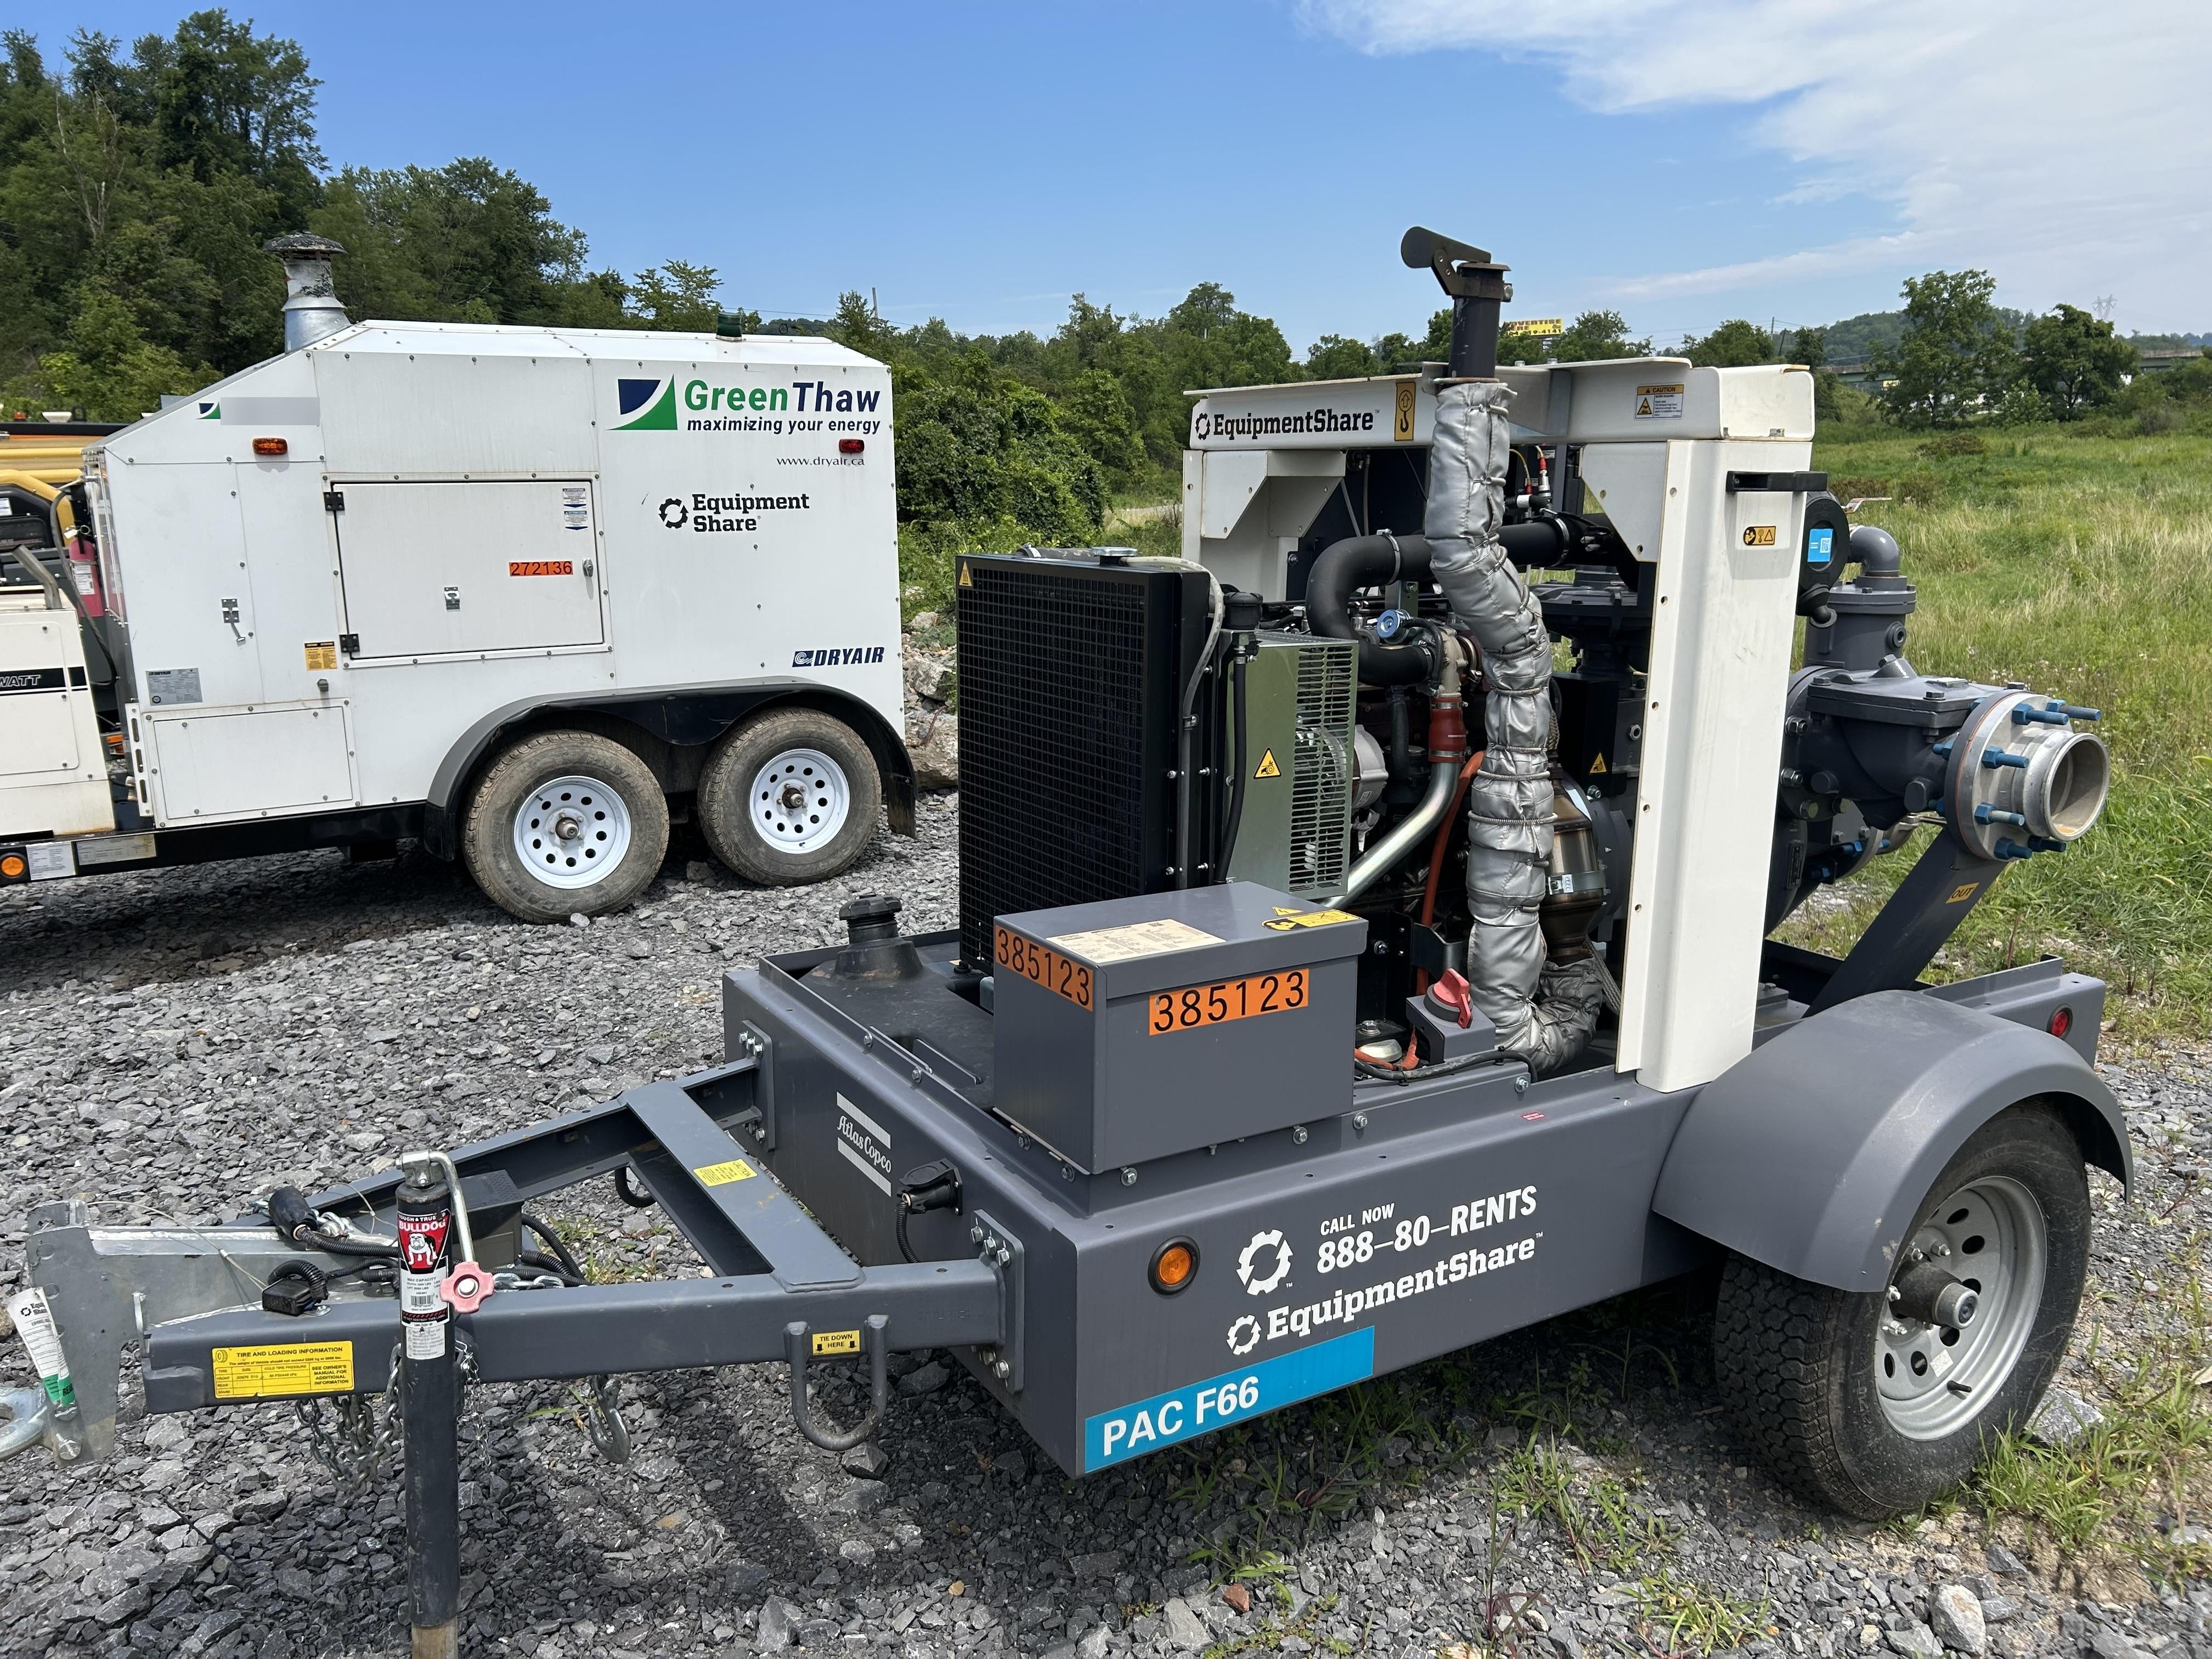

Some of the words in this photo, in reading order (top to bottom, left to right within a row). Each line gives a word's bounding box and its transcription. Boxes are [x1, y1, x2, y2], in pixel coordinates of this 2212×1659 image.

[687, 416, 782, 434] maximizing
[788, 419, 823, 435] your
[828, 419, 881, 435] energy
[1214, 409, 1373, 440] EquipmentShare
[776, 456, 865, 466] www.dryair.ca
[692, 493, 810, 514] Equipment
[693, 515, 757, 532] Share
[511, 561, 572, 576] 272136
[814, 647, 885, 666] DRYAIR
[1951, 887, 1974, 898] OUT
[997, 928, 1091, 1007] 385123
[1154, 971, 1304, 1031] 385123
[733, 1162, 751, 1177] CAUTION
[399, 1219, 446, 1232] BULLDOG
[1320, 1211, 1355, 1235] CALL
[1362, 1203, 1395, 1225] NOW
[1267, 1234, 1535, 1341] EquipmentShare
[1104, 1401, 1183, 1457] PAC
[1195, 1376, 1259, 1426] F66
